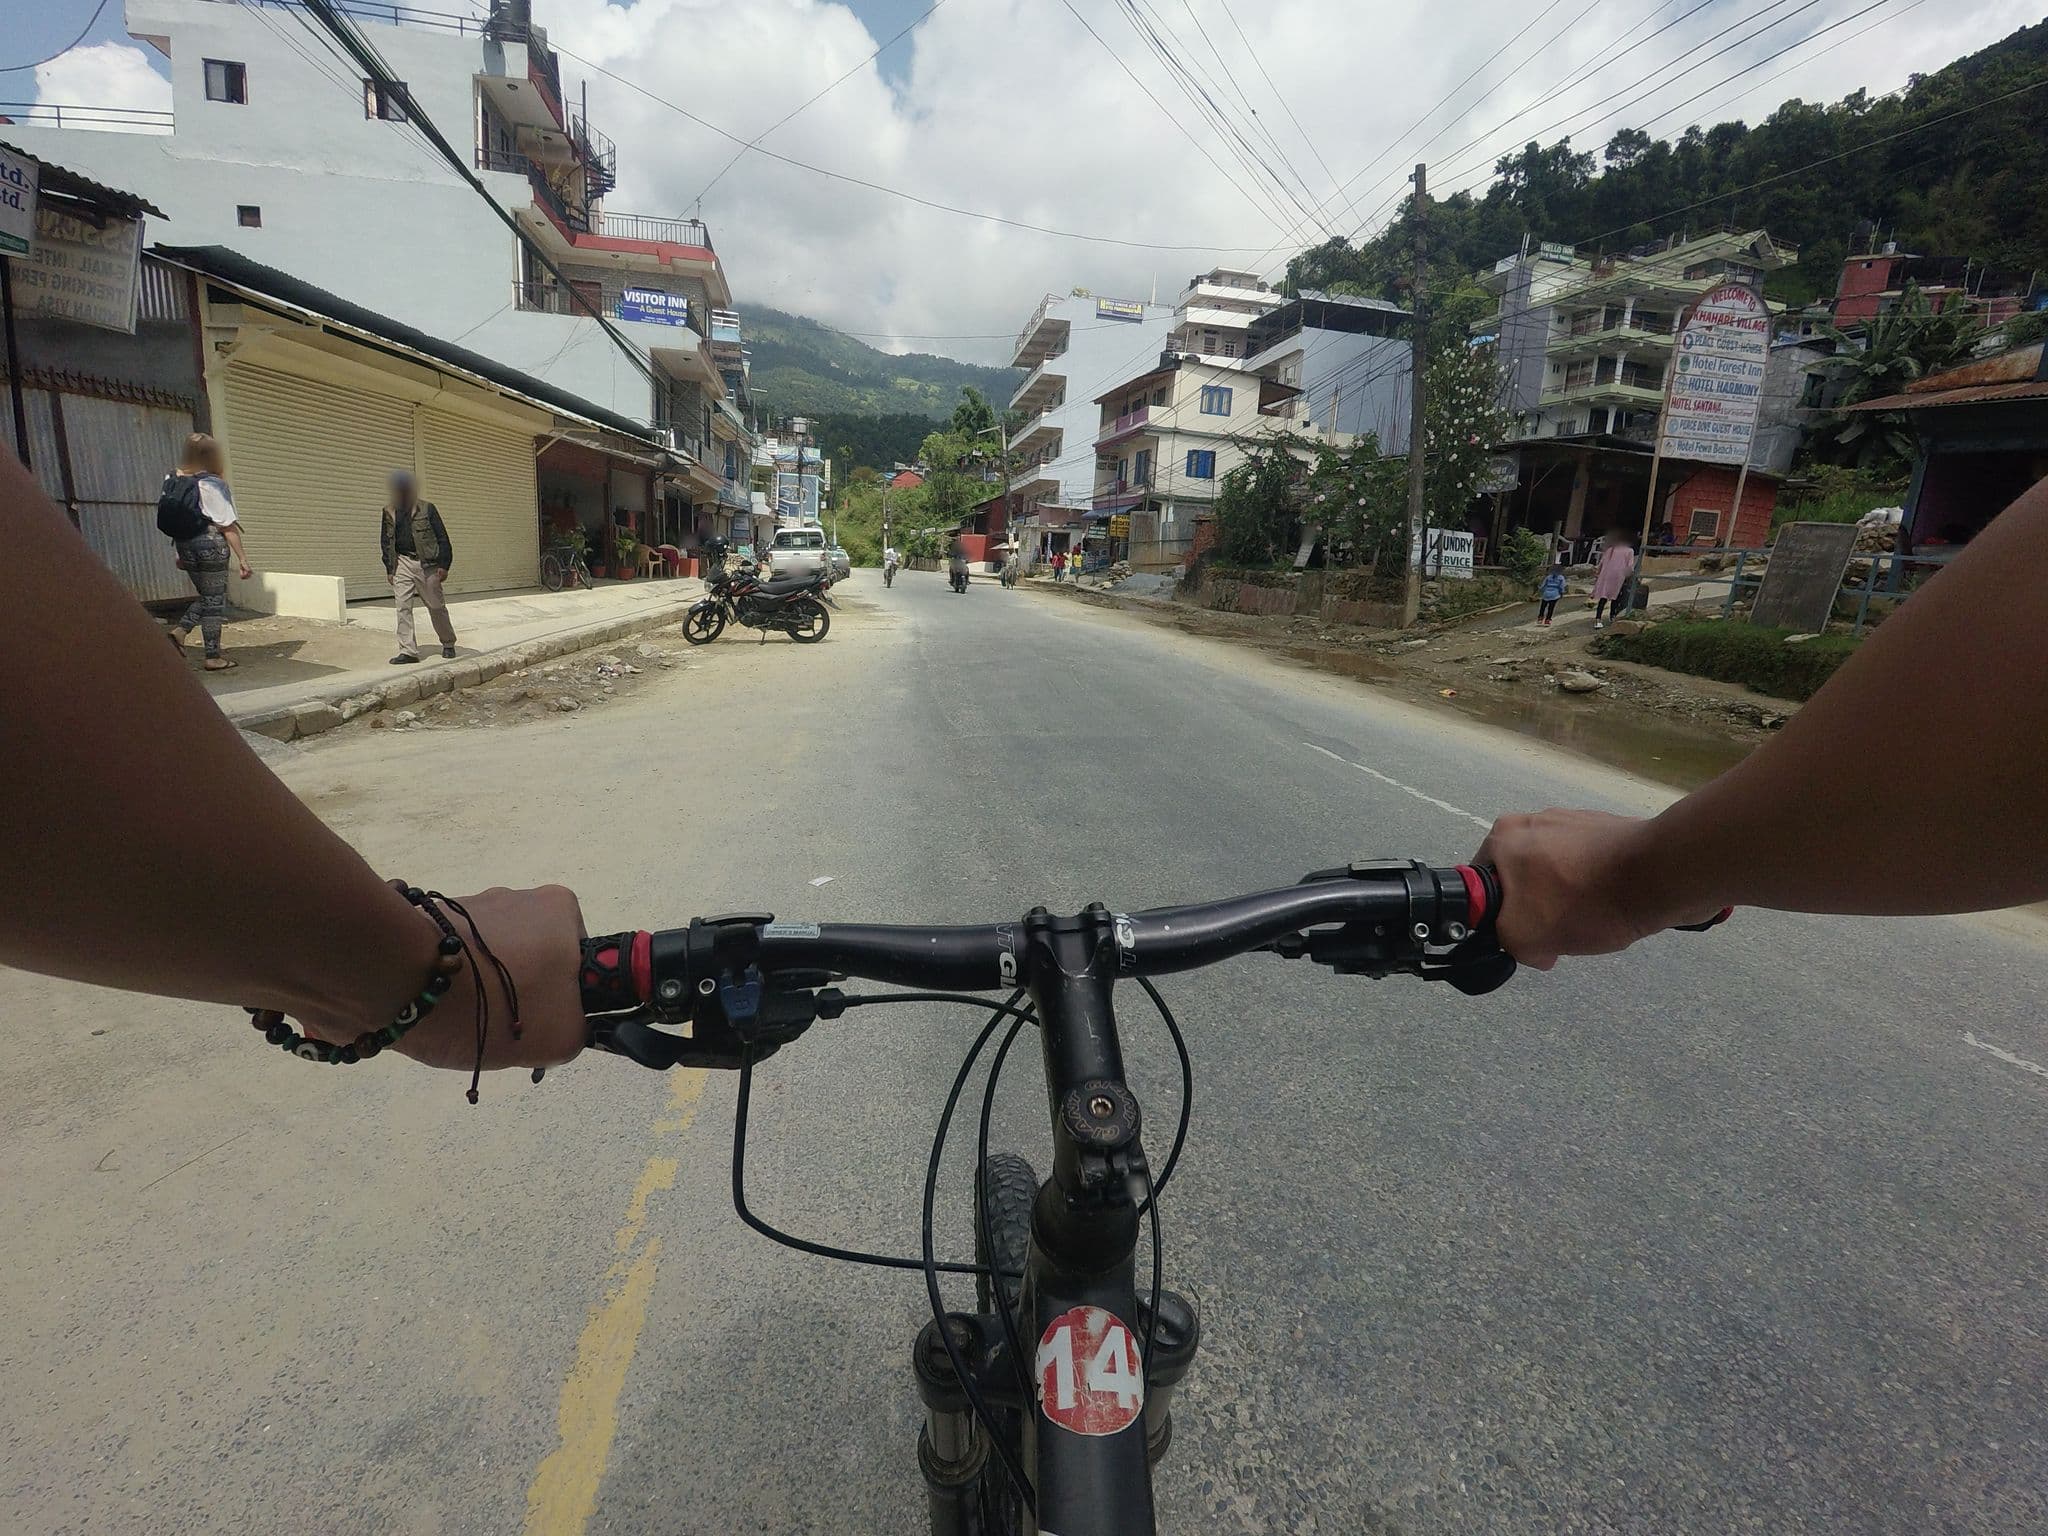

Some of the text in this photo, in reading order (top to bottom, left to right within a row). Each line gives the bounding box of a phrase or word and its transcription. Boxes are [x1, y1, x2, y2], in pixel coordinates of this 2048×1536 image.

[624, 290, 688, 309] VISITOR INN
[1711, 287, 1750, 305] WELCOME
[646, 305, 665, 315] Guest
[666, 308, 687, 318] House
[1736, 316, 1768, 332] VILLAGE
[1692, 355, 1717, 370] Hotel
[1718, 360, 1748, 374] Forest
[1748, 361, 1762, 377] Inn
[1688, 377, 1714, 393] HOTEL
[1717, 380, 1760, 397] HARMONY
[1671, 396, 1692, 411] HOTEL
[1430, 533, 1472, 553] LUNDRY
[1432, 554, 1470, 567] SRVICE
[1039, 1325, 1141, 1410] 14
